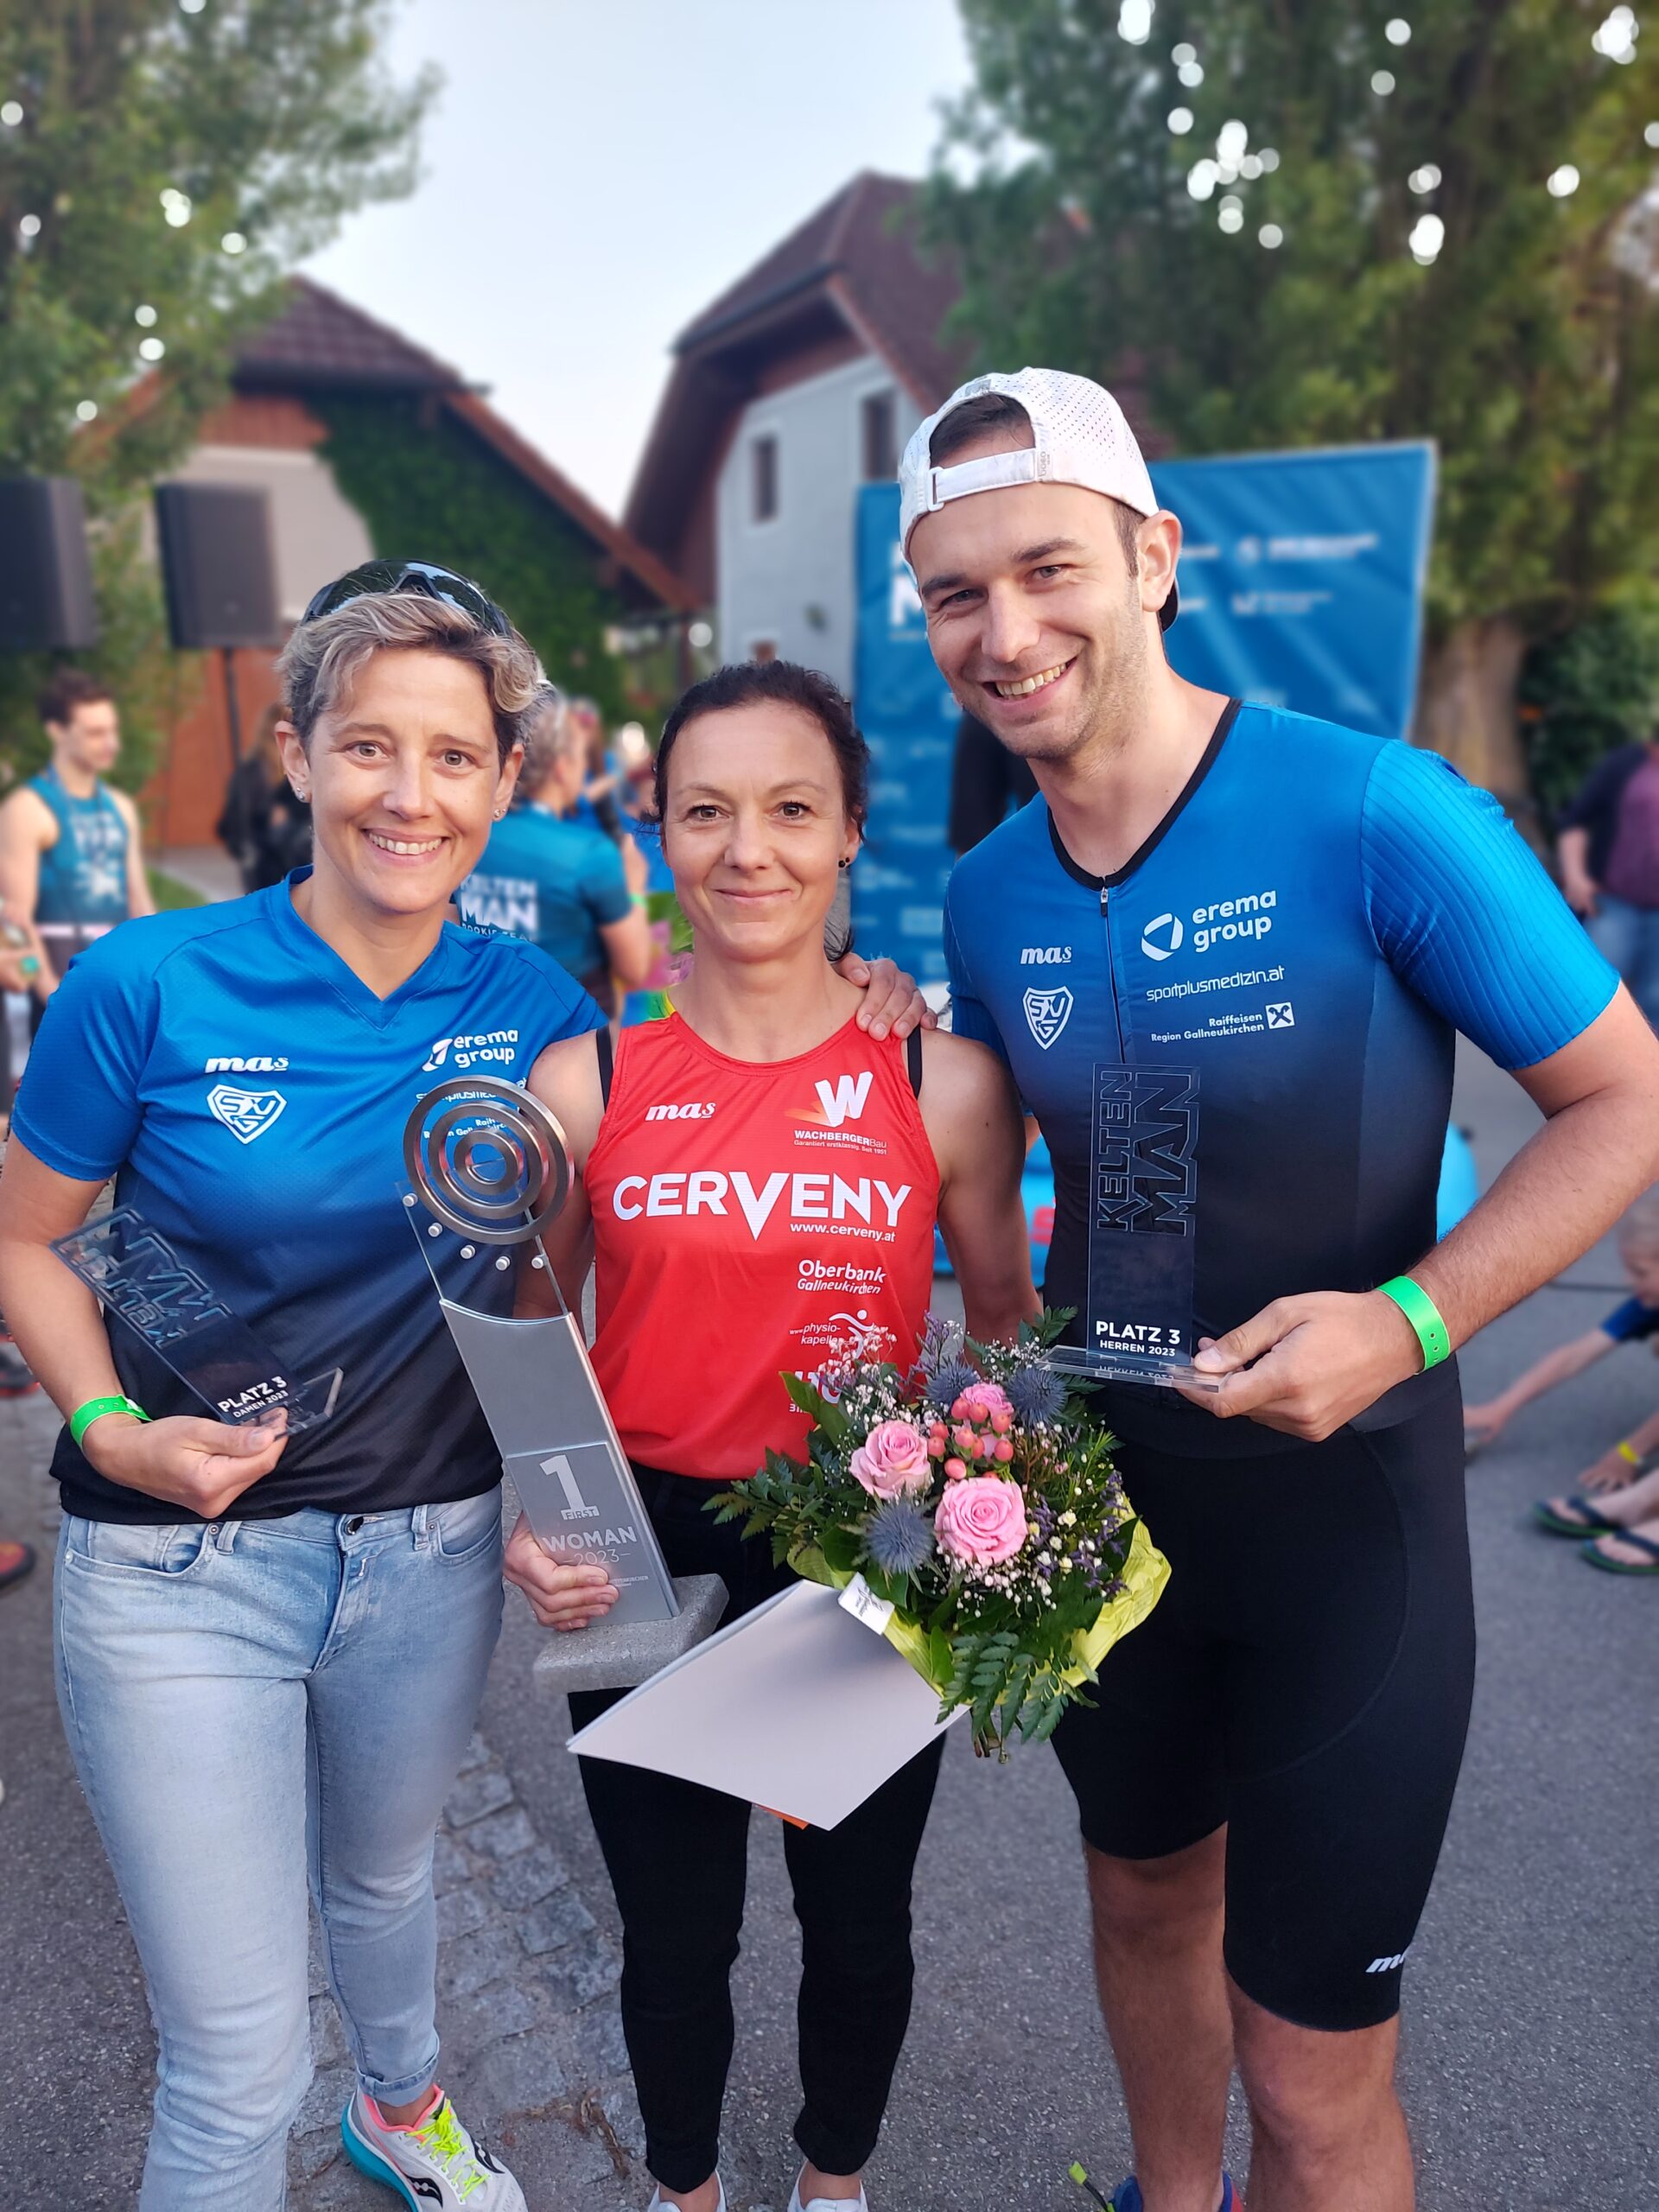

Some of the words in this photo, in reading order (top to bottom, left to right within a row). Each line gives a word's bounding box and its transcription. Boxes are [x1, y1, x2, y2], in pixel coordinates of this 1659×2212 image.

[1192, 890, 1277, 925] erema
[1193, 915, 1272, 952] group
[1147, 965, 1285, 1002] sportplusmedizin.at
[1209, 1014, 1263, 1027] Raiffeisen
[454, 1029, 518, 1049] erema
[1151, 1033, 1181, 1043] Region
[1184, 1024, 1264, 1039] Gallneukirchen
[454, 1047, 515, 1069] group
[1096, 1071, 1133, 1232] KELTEN
[1130, 1071, 1192, 1236] MAN
[613, 1171, 912, 1241] CERVENY
[790, 1222, 895, 1243] www.cerveny.at
[798, 1259, 887, 1283] Oberbank
[797, 1278, 881, 1294] Gallneukirchen
[1096, 1320, 1161, 1343] PLATZ
[1168, 1329, 1180, 1344] 3
[1099, 1339, 1145, 1353] HERREN
[1148, 1346, 1175, 1357] 2023
[217, 1382, 274, 1413] PLATZ
[271, 1376, 287, 1389] 3
[233, 1400, 266, 1418] DAMEN
[265, 1389, 289, 1404] 2023
[539, 1455, 599, 1521] 1
[564, 1507, 596, 1521] FIRST
[543, 1526, 637, 1552] WOMAN
[574, 1549, 620, 1566] 2023
